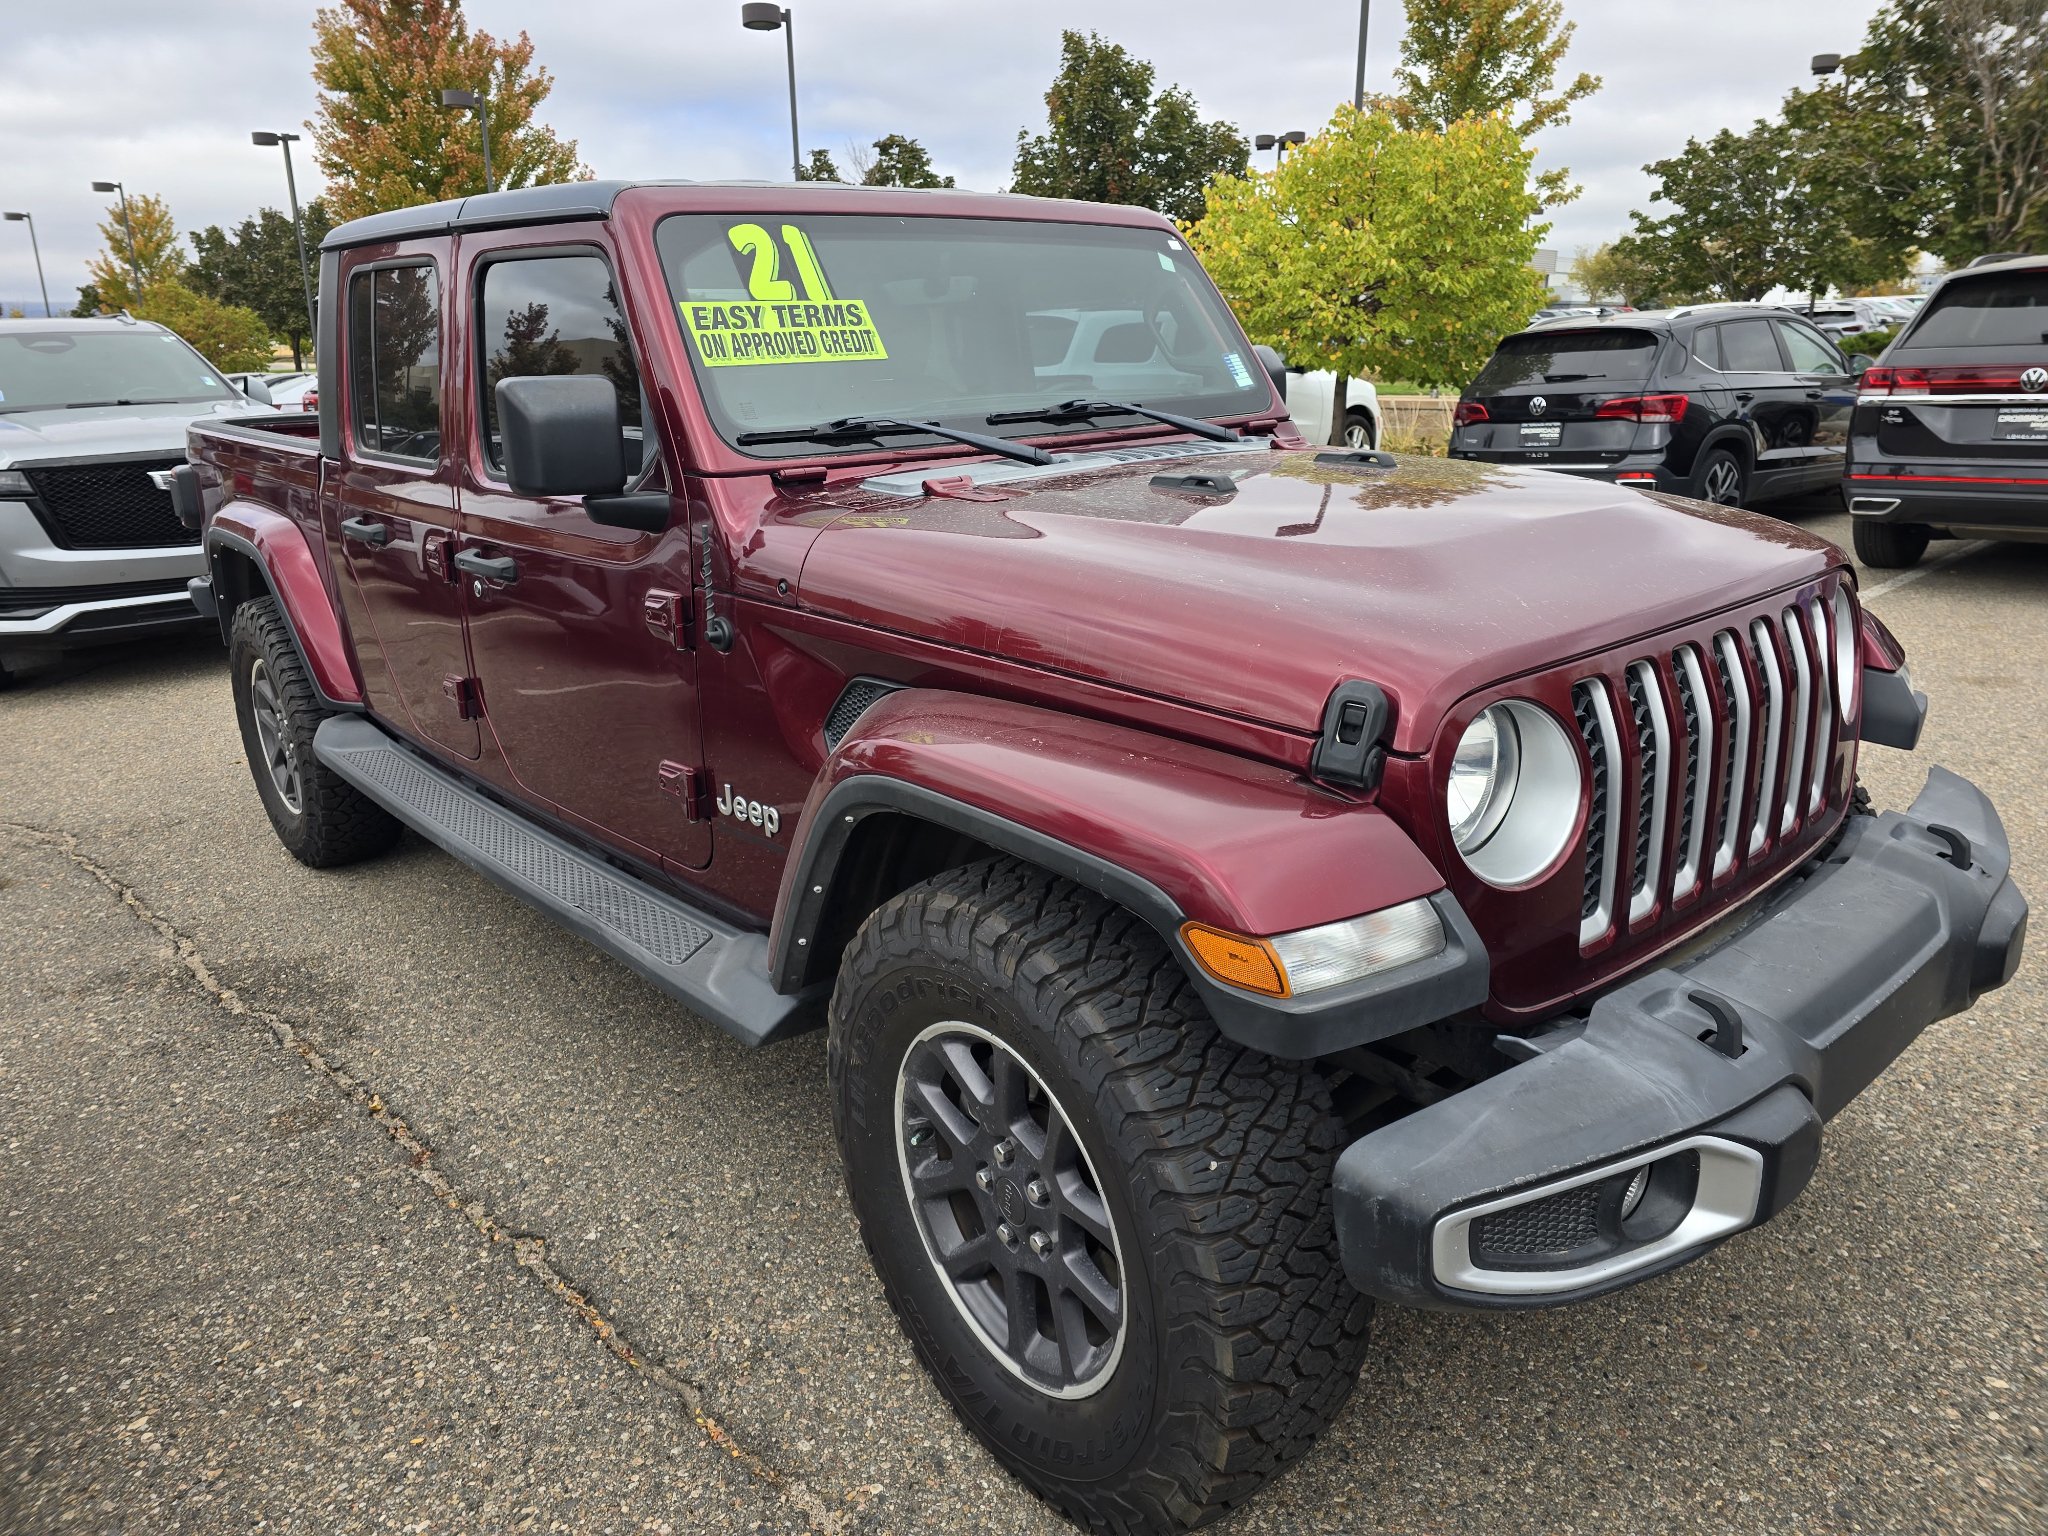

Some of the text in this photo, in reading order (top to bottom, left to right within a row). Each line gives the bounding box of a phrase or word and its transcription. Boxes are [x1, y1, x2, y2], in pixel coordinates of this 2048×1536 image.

[728, 223, 835, 300] 21
[691, 304, 864, 330] EASY TERMS
[699, 329, 875, 358] ON APPROVED CREDIT
[716, 783, 780, 838] Jeep
